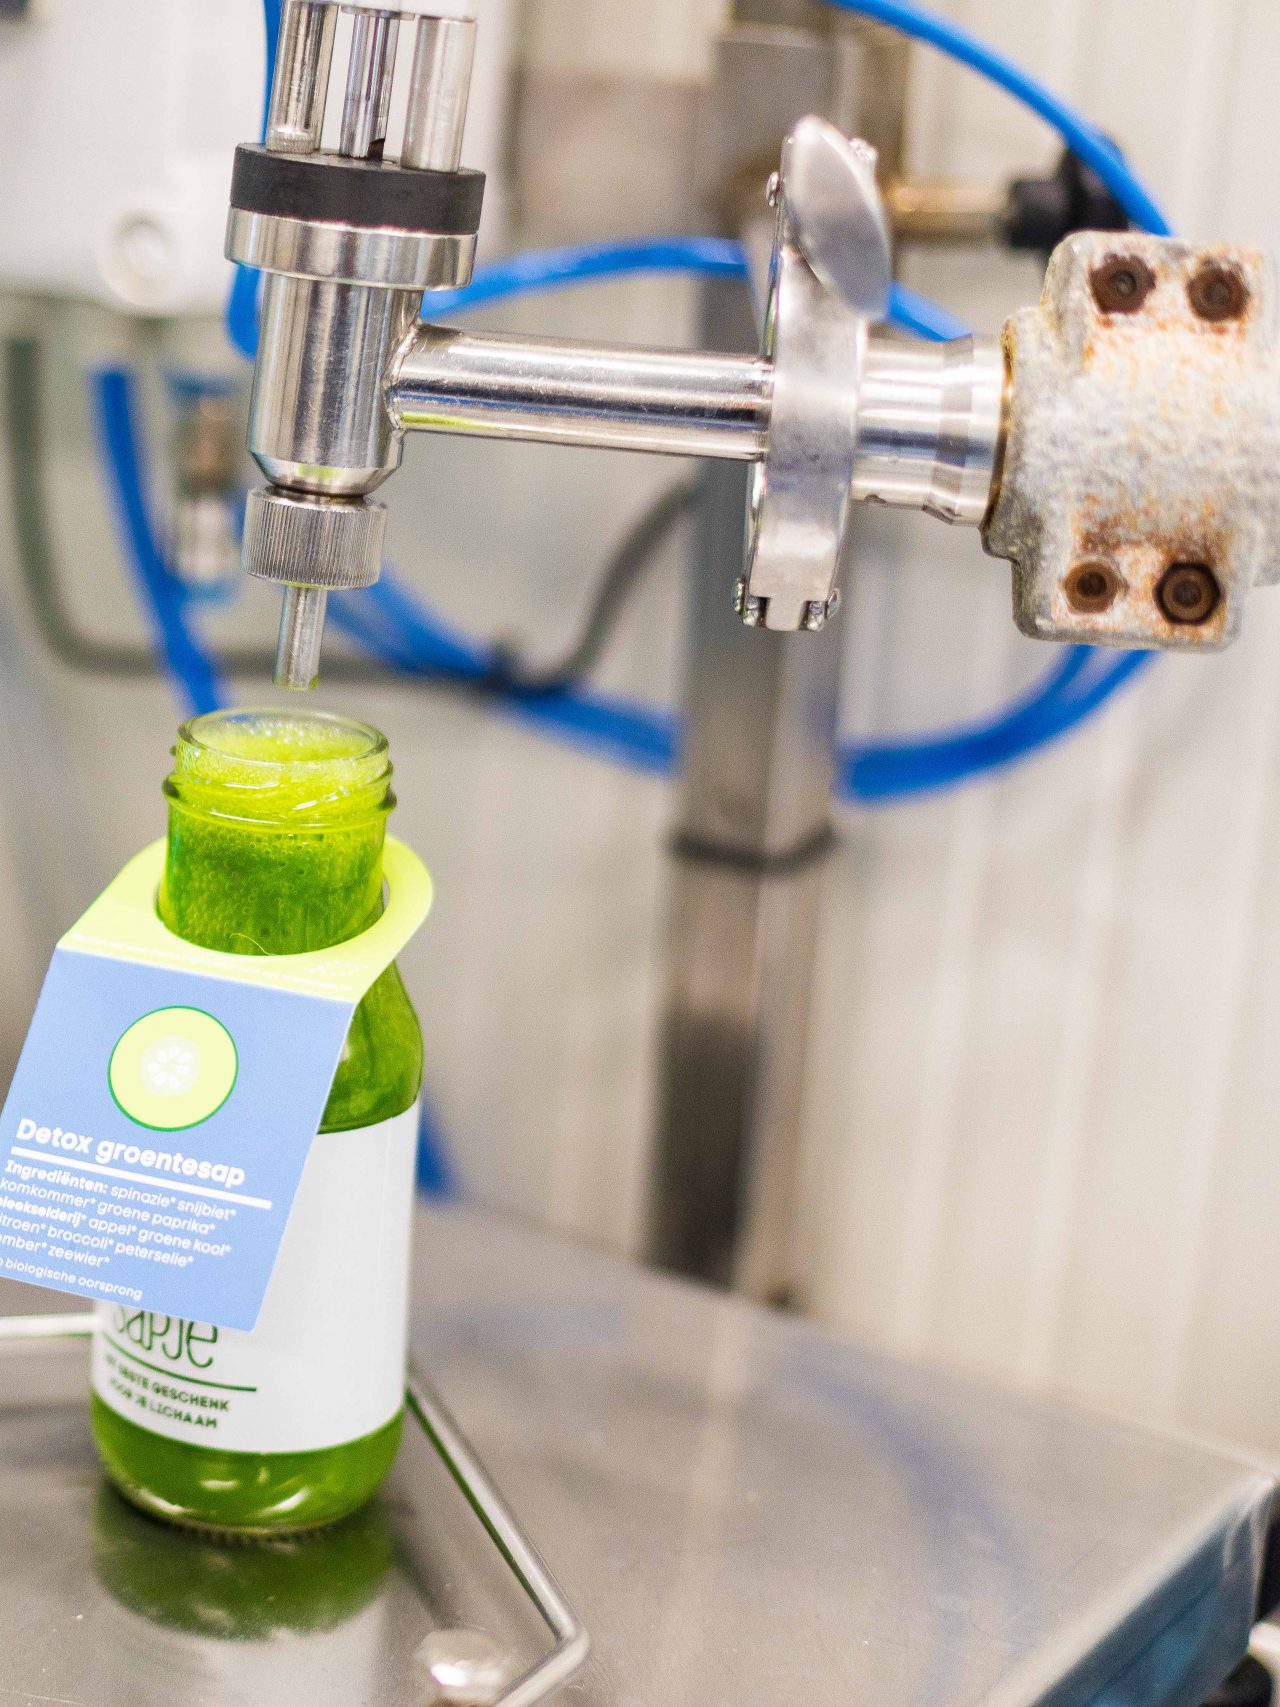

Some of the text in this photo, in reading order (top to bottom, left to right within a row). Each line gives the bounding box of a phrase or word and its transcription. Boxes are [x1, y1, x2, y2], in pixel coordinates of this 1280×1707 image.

[16, 1118, 245, 1188] Detox groentesap
[4, 1159, 108, 1194] Ingrediënten:
[97, 1201, 150, 1222] groene
[137, 1229, 192, 1249] groene
[5, 1257, 77, 1284] biologische
[78, 1276, 143, 1301] oorsprong
[151, 1381, 230, 1412] GESCHENK
[149, 1399, 218, 1429] LICHAAM
